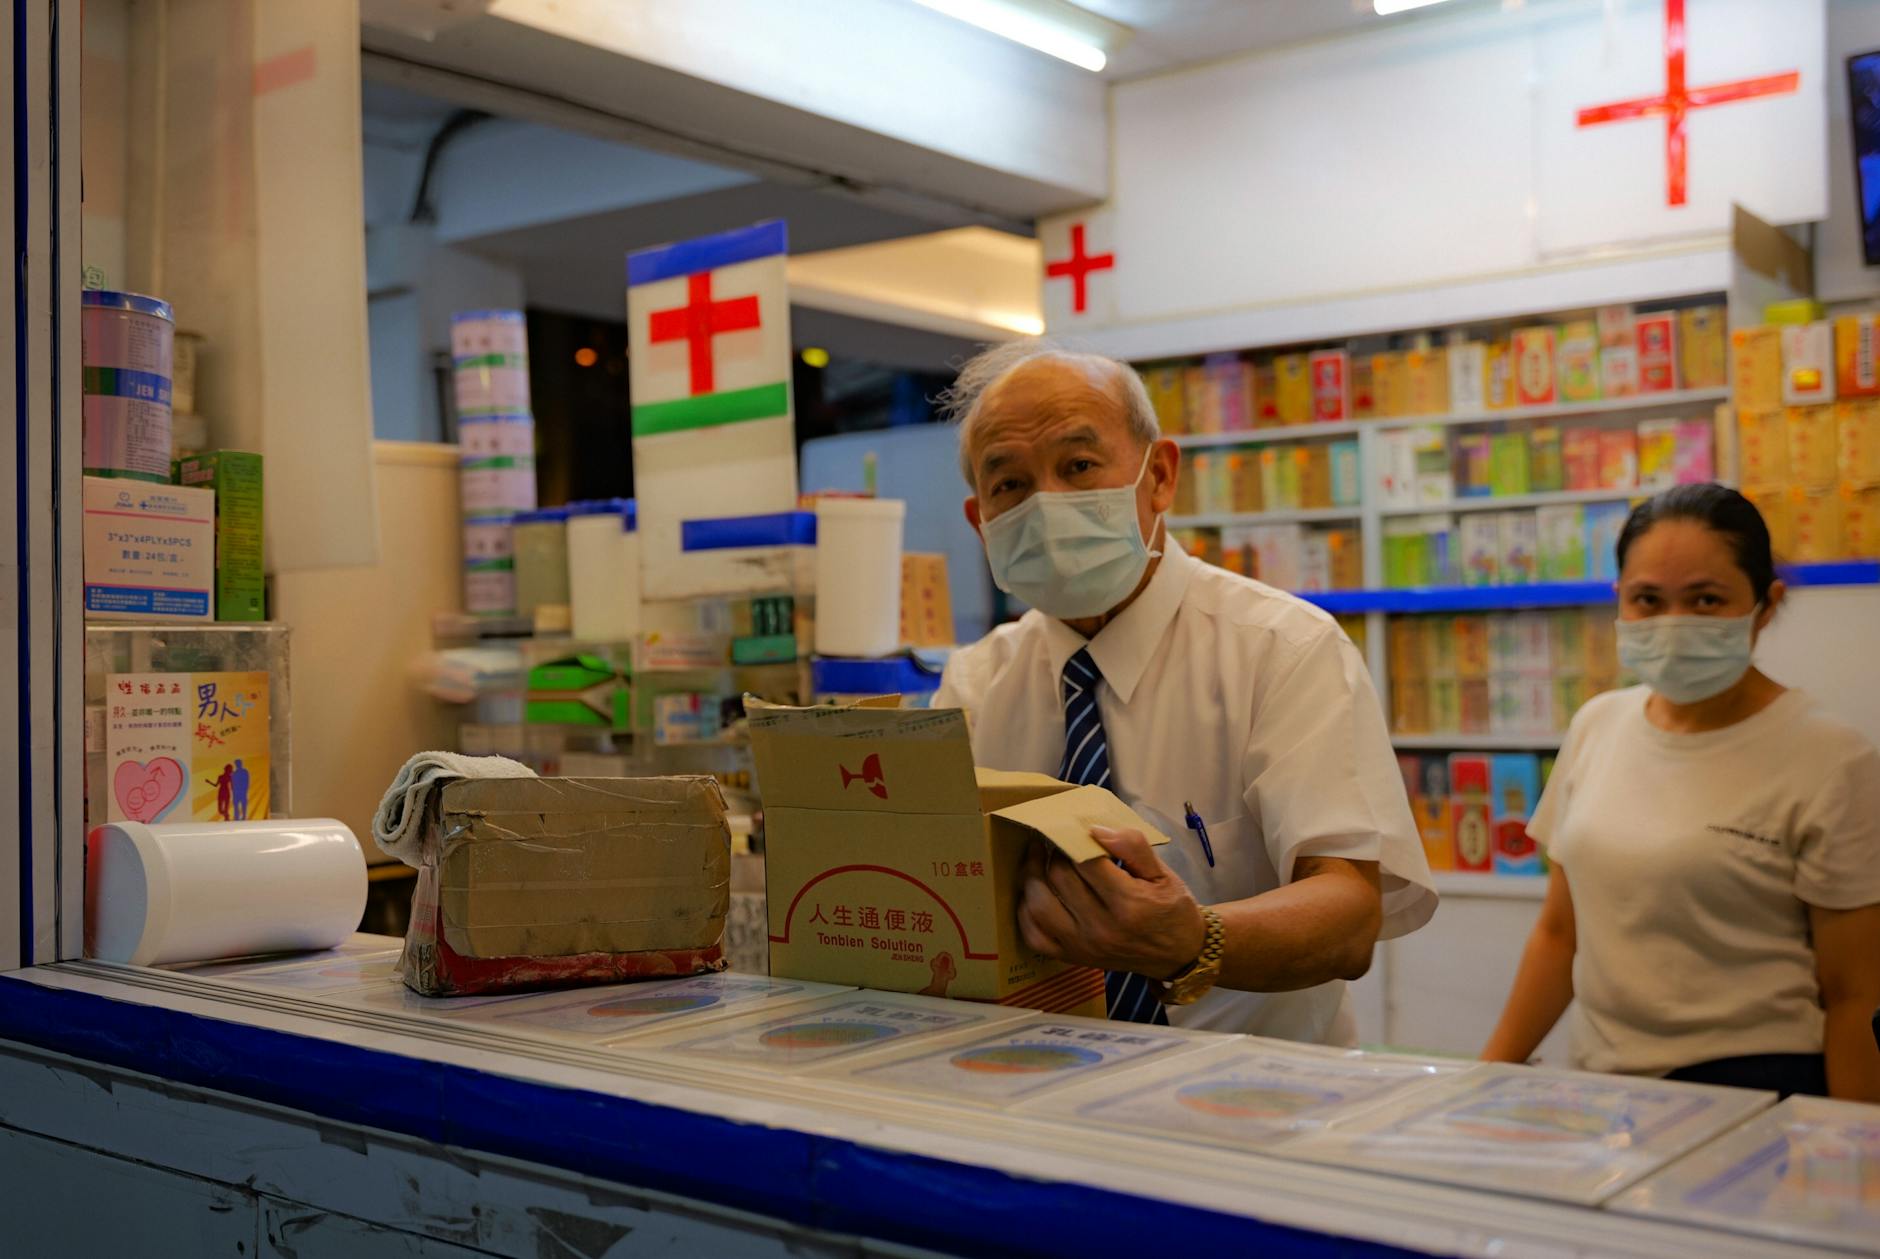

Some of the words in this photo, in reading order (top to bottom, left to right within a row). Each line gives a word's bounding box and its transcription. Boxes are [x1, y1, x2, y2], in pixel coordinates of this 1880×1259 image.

[809, 903, 934, 934] 人生通便液
[871, 936, 924, 953] Solution
